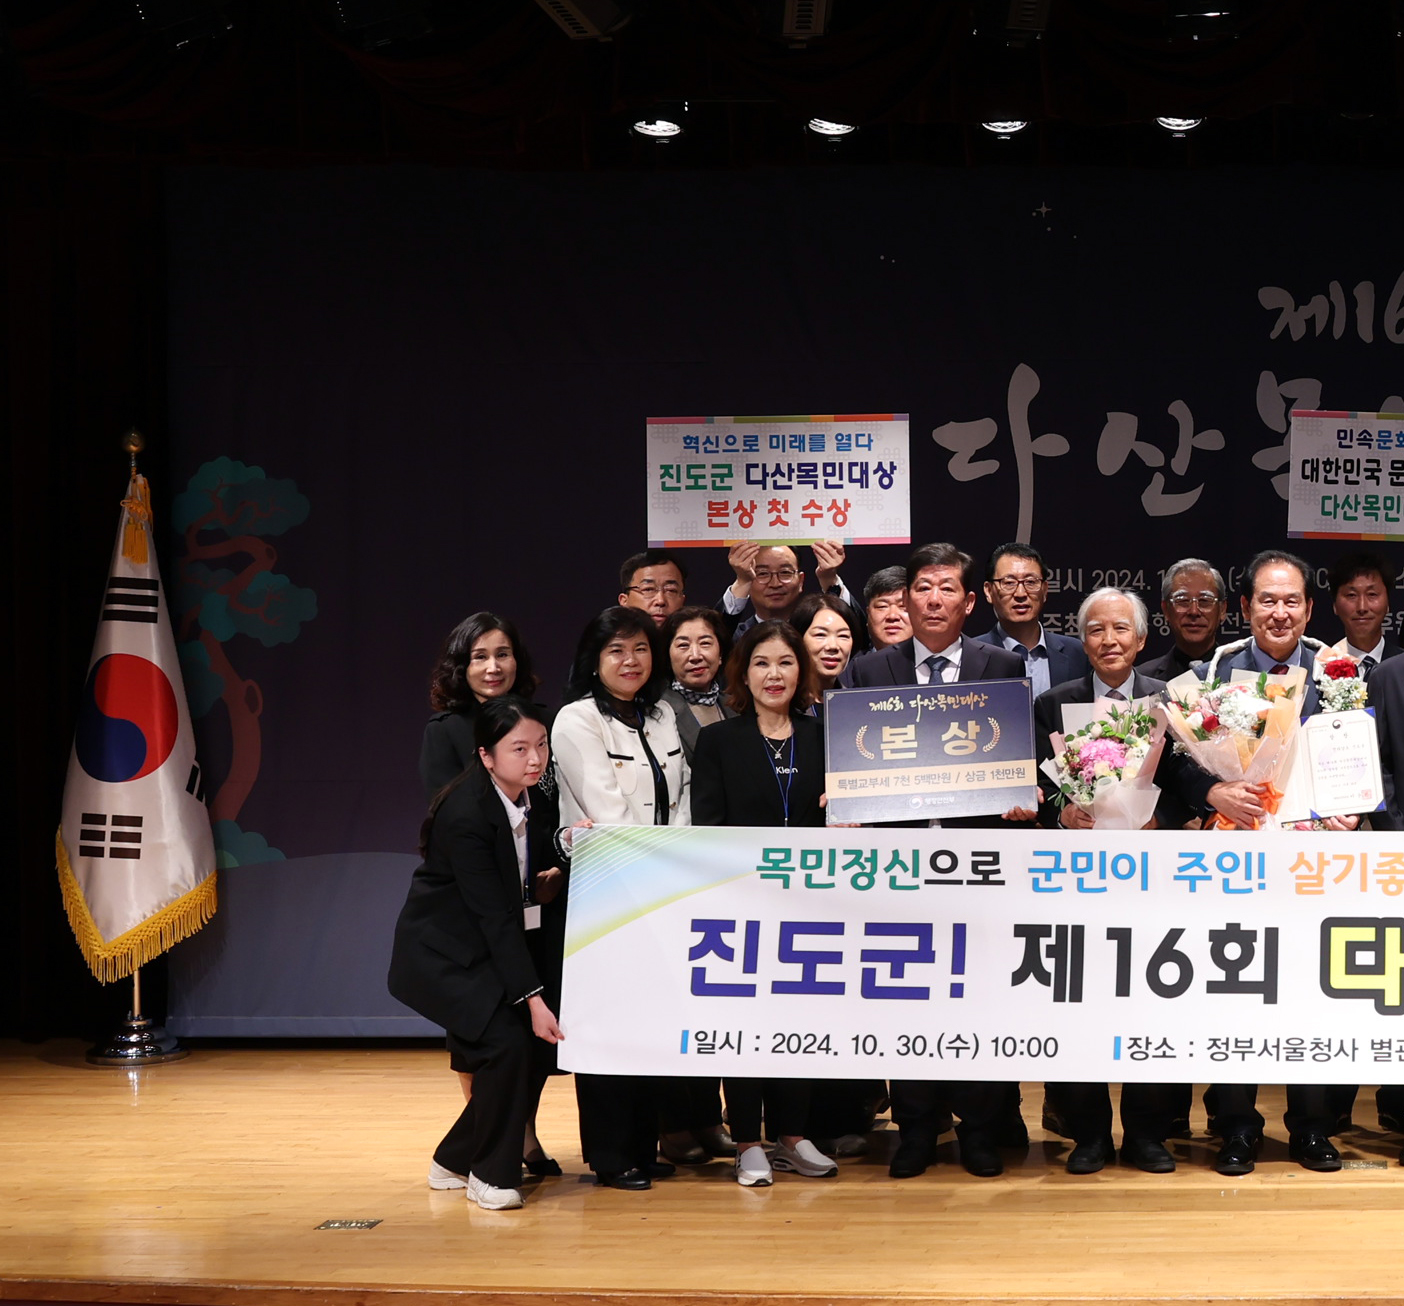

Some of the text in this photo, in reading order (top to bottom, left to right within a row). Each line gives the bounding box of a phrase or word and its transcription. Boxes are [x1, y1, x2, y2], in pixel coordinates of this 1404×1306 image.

[683, 433, 873, 453] 혁신으로 미래를 열다
[660, 461, 897, 491] 진도군 다산목민대상
[1302, 457, 1382, 486] 대한민국
[707, 498, 851, 528] 본상 첫 수상
[909, 692, 989, 723] 다산목민대상
[775, 766, 799, 774] Klen
[837, 777, 890, 790] 특별교부세
[965, 771, 986, 783] 상금
[990, 767, 1026, 780] 1천만원
[756, 848, 1005, 891] 목민정신으로
[1028, 851, 1148, 893] 군민이
[1173, 852, 1266, 894] 주인!
[688, 919, 966, 1000] 진도군!
[1011, 923, 1279, 1004] 제16회
[695, 1030, 742, 1055] 일시
[771, 1033, 838, 1056] 2024.
[852, 1035, 884, 1056] 10.
[896, 1033, 979, 1059] 30.(수)
[991, 1037, 1058, 1058] 10:00
[1127, 1036, 1176, 1061] 장소
[1207, 1037, 1358, 1062] 정부서울청사
